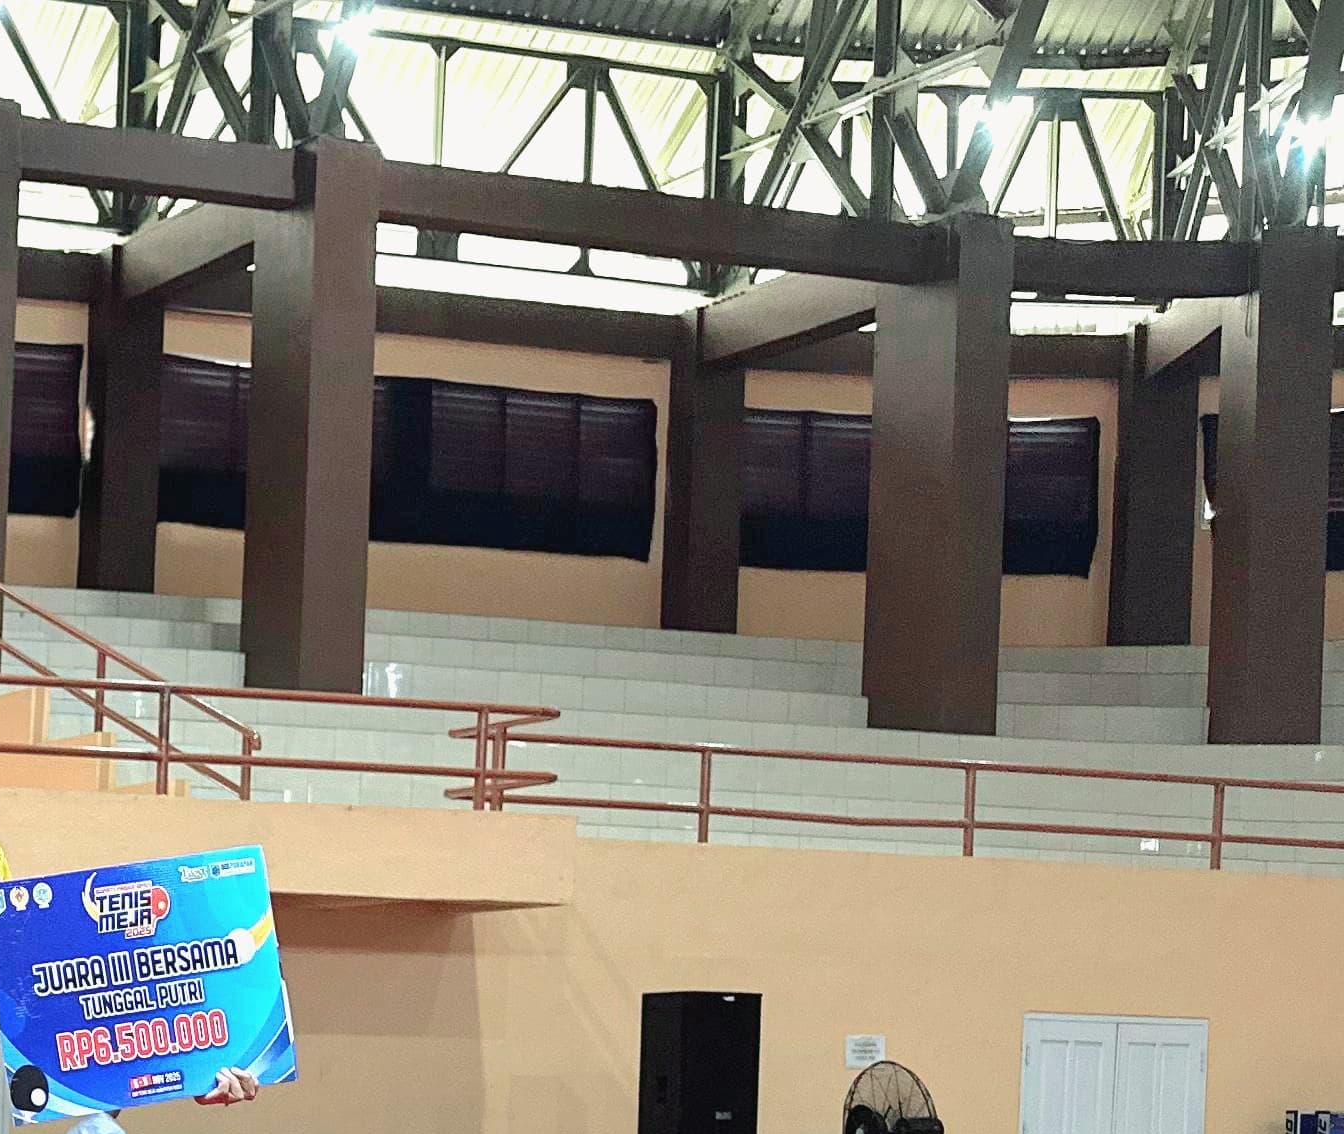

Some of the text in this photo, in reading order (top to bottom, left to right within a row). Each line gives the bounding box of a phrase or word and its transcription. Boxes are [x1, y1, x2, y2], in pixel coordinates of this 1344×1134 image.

[96, 889, 152, 913] TENIS
[98, 908, 152, 932] MEJA
[33, 939, 238, 995] JUARA III BERSAMA
[81, 980, 204, 1018] TUNGGAL PUTRI
[57, 1012, 228, 1070] RP6.500.000
